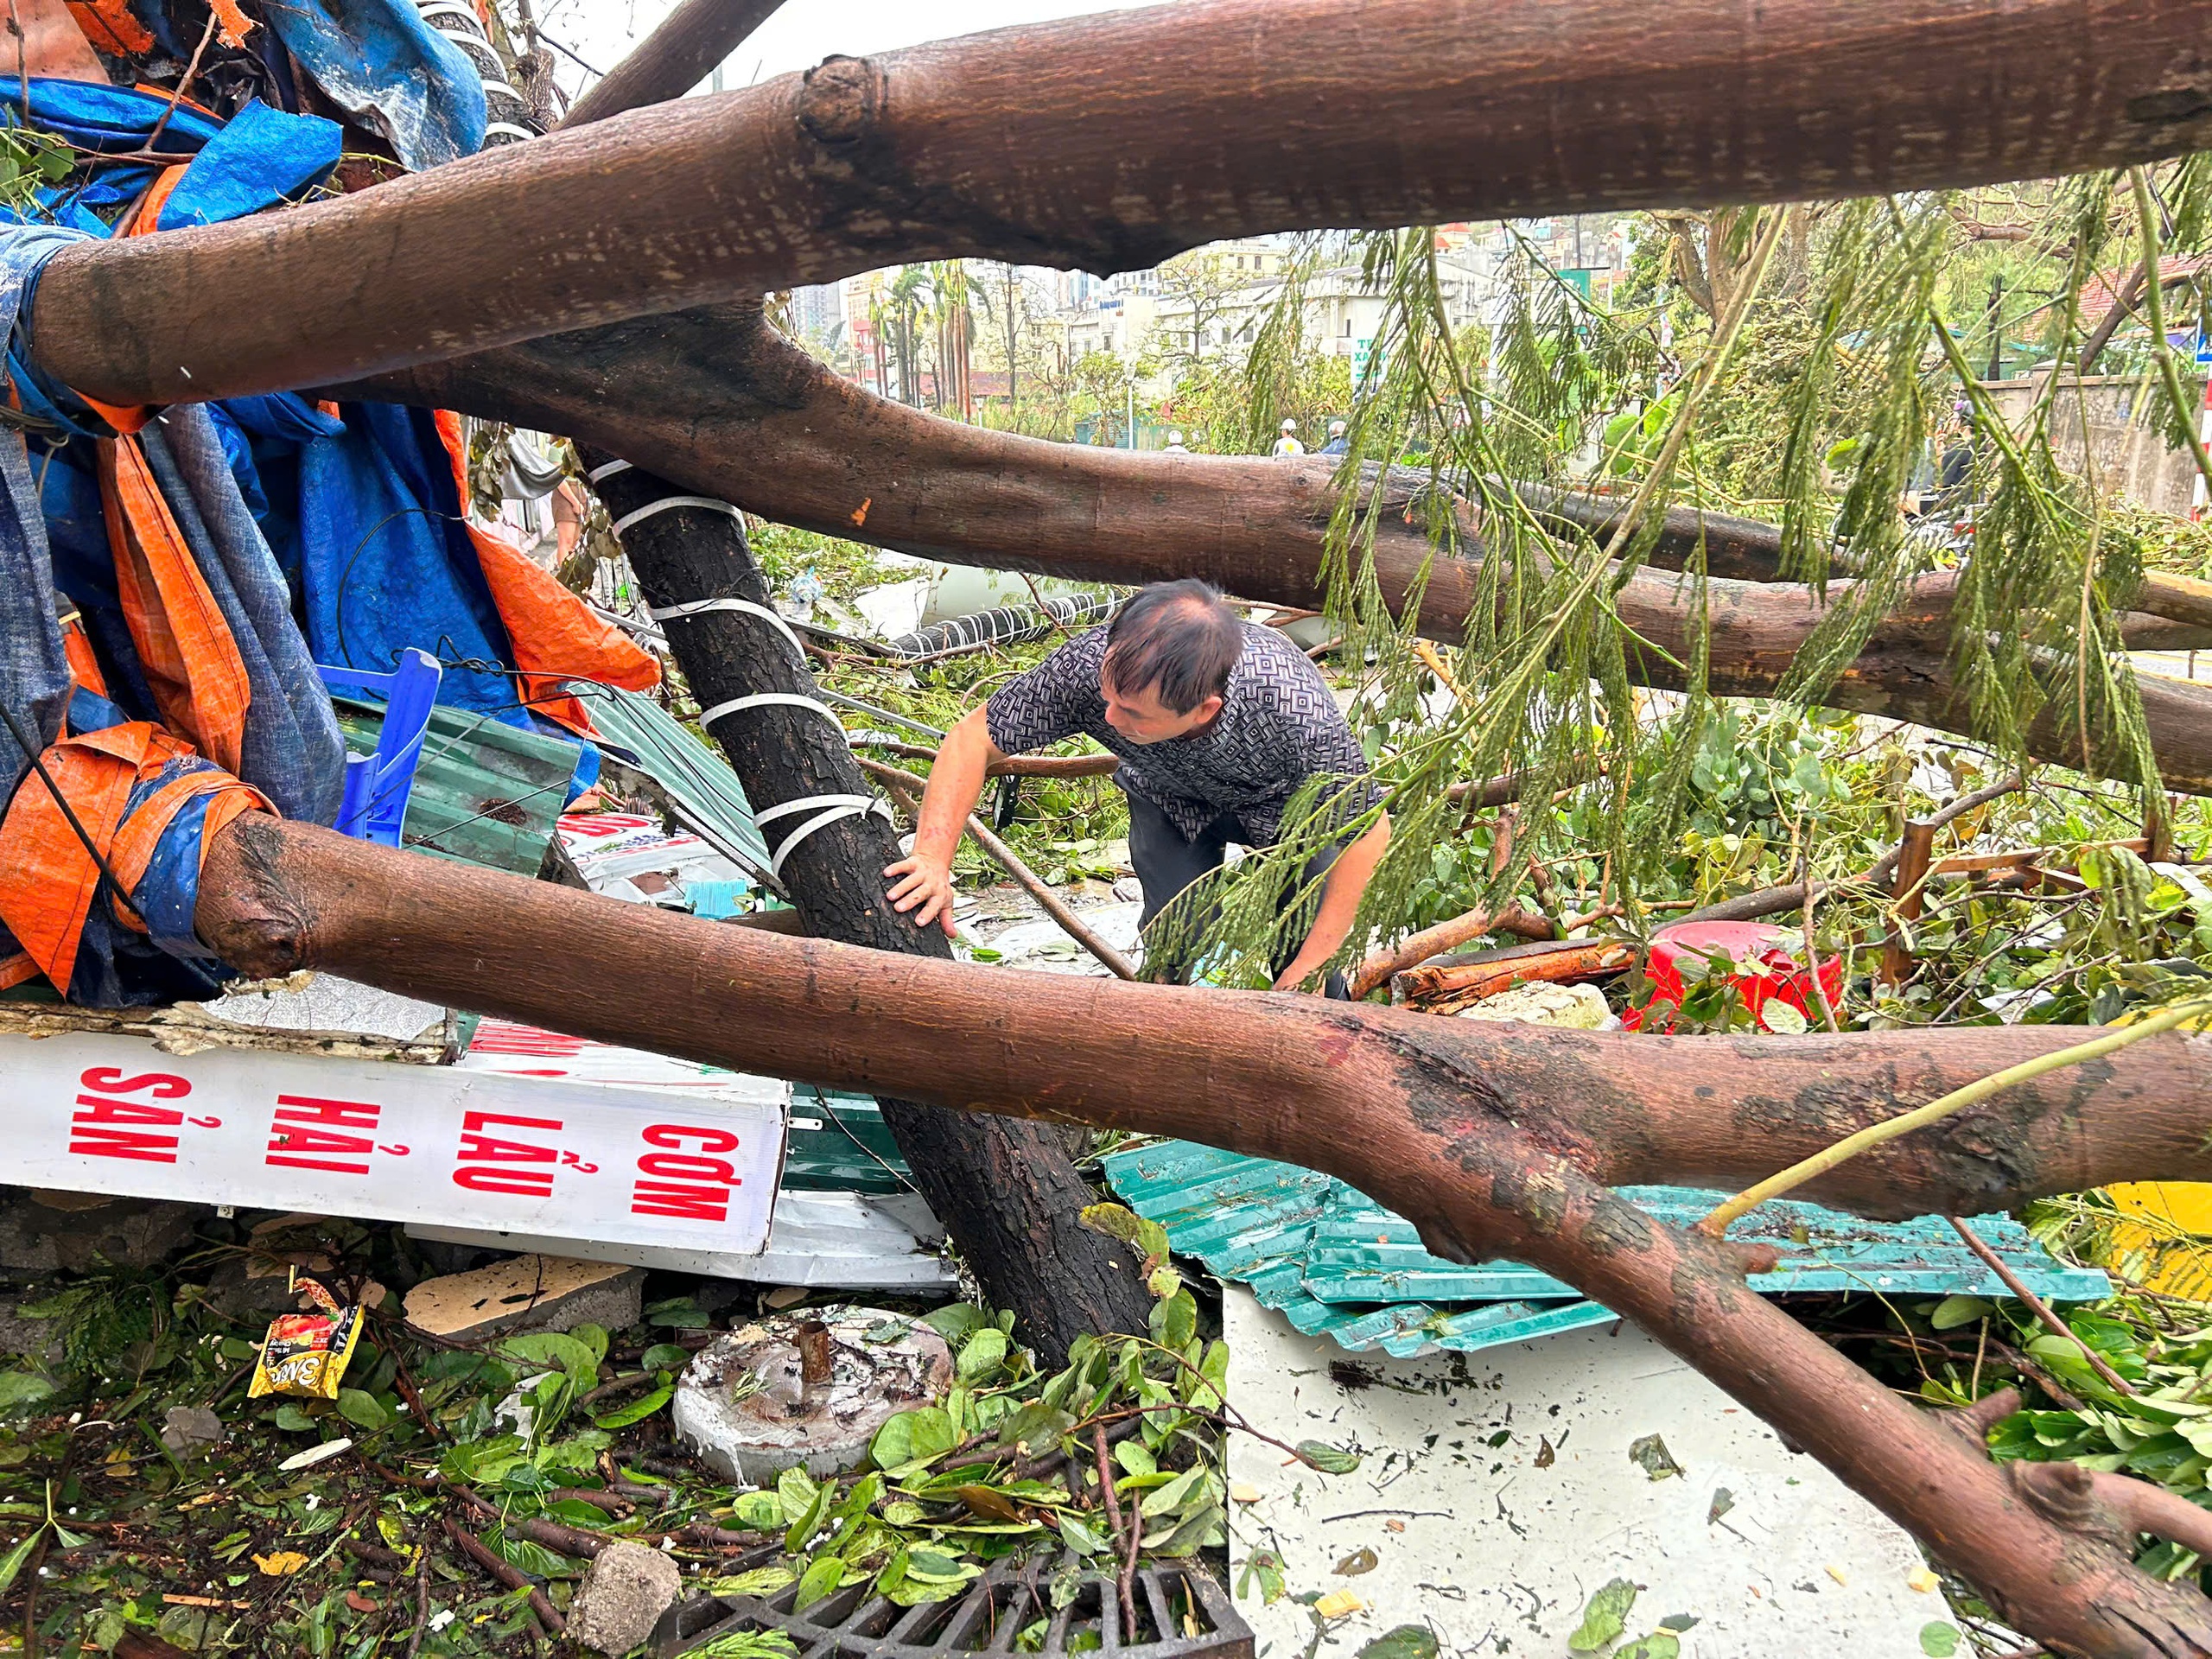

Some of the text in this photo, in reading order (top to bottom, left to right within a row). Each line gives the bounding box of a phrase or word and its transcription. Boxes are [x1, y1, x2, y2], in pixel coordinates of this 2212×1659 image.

[69, 1067, 222, 1163] SẢN
[266, 1095, 410, 1175] HẢI
[453, 1111, 599, 1198] LẨU
[632, 1124, 742, 1222] CƠM
